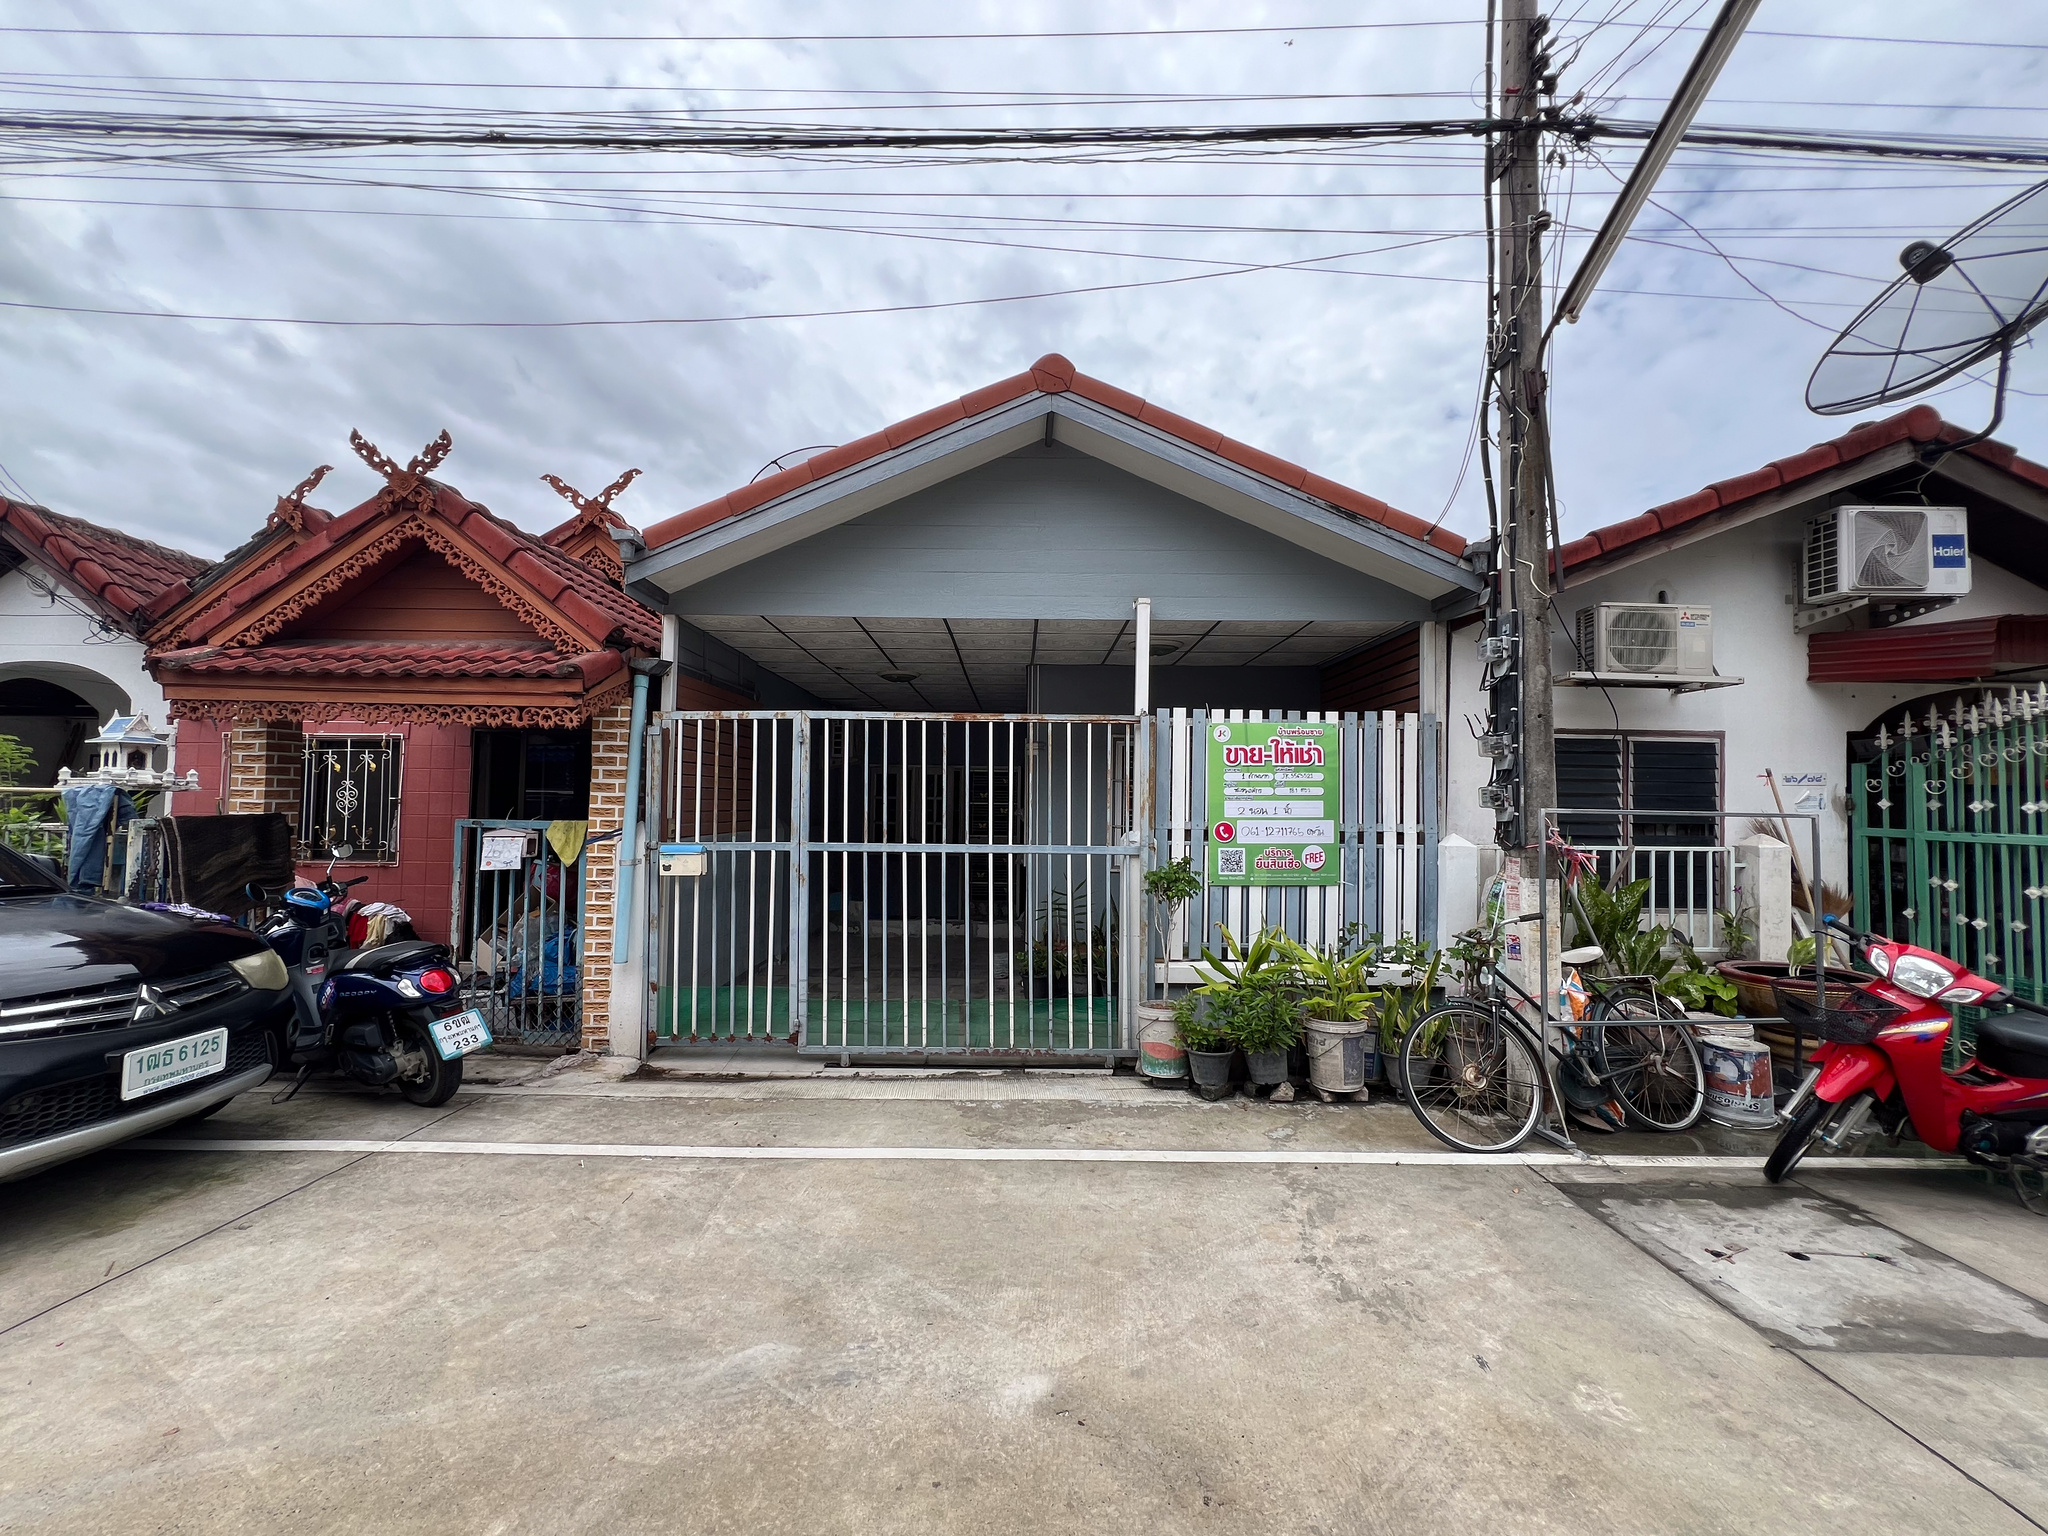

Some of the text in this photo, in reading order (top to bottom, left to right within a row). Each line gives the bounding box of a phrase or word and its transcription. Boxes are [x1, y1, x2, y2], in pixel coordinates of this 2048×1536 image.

[1933, 546, 1964, 557] Haier
[1225, 739, 1323, 764] ขาย-ให้เช่า
[1237, 806, 1246, 816] 2
[1264, 847, 1293, 857] บริการ
[1304, 851, 1324, 864] FREE
[178, 1036, 220, 1061] 6125
[453, 1034, 479, 1050] 233
